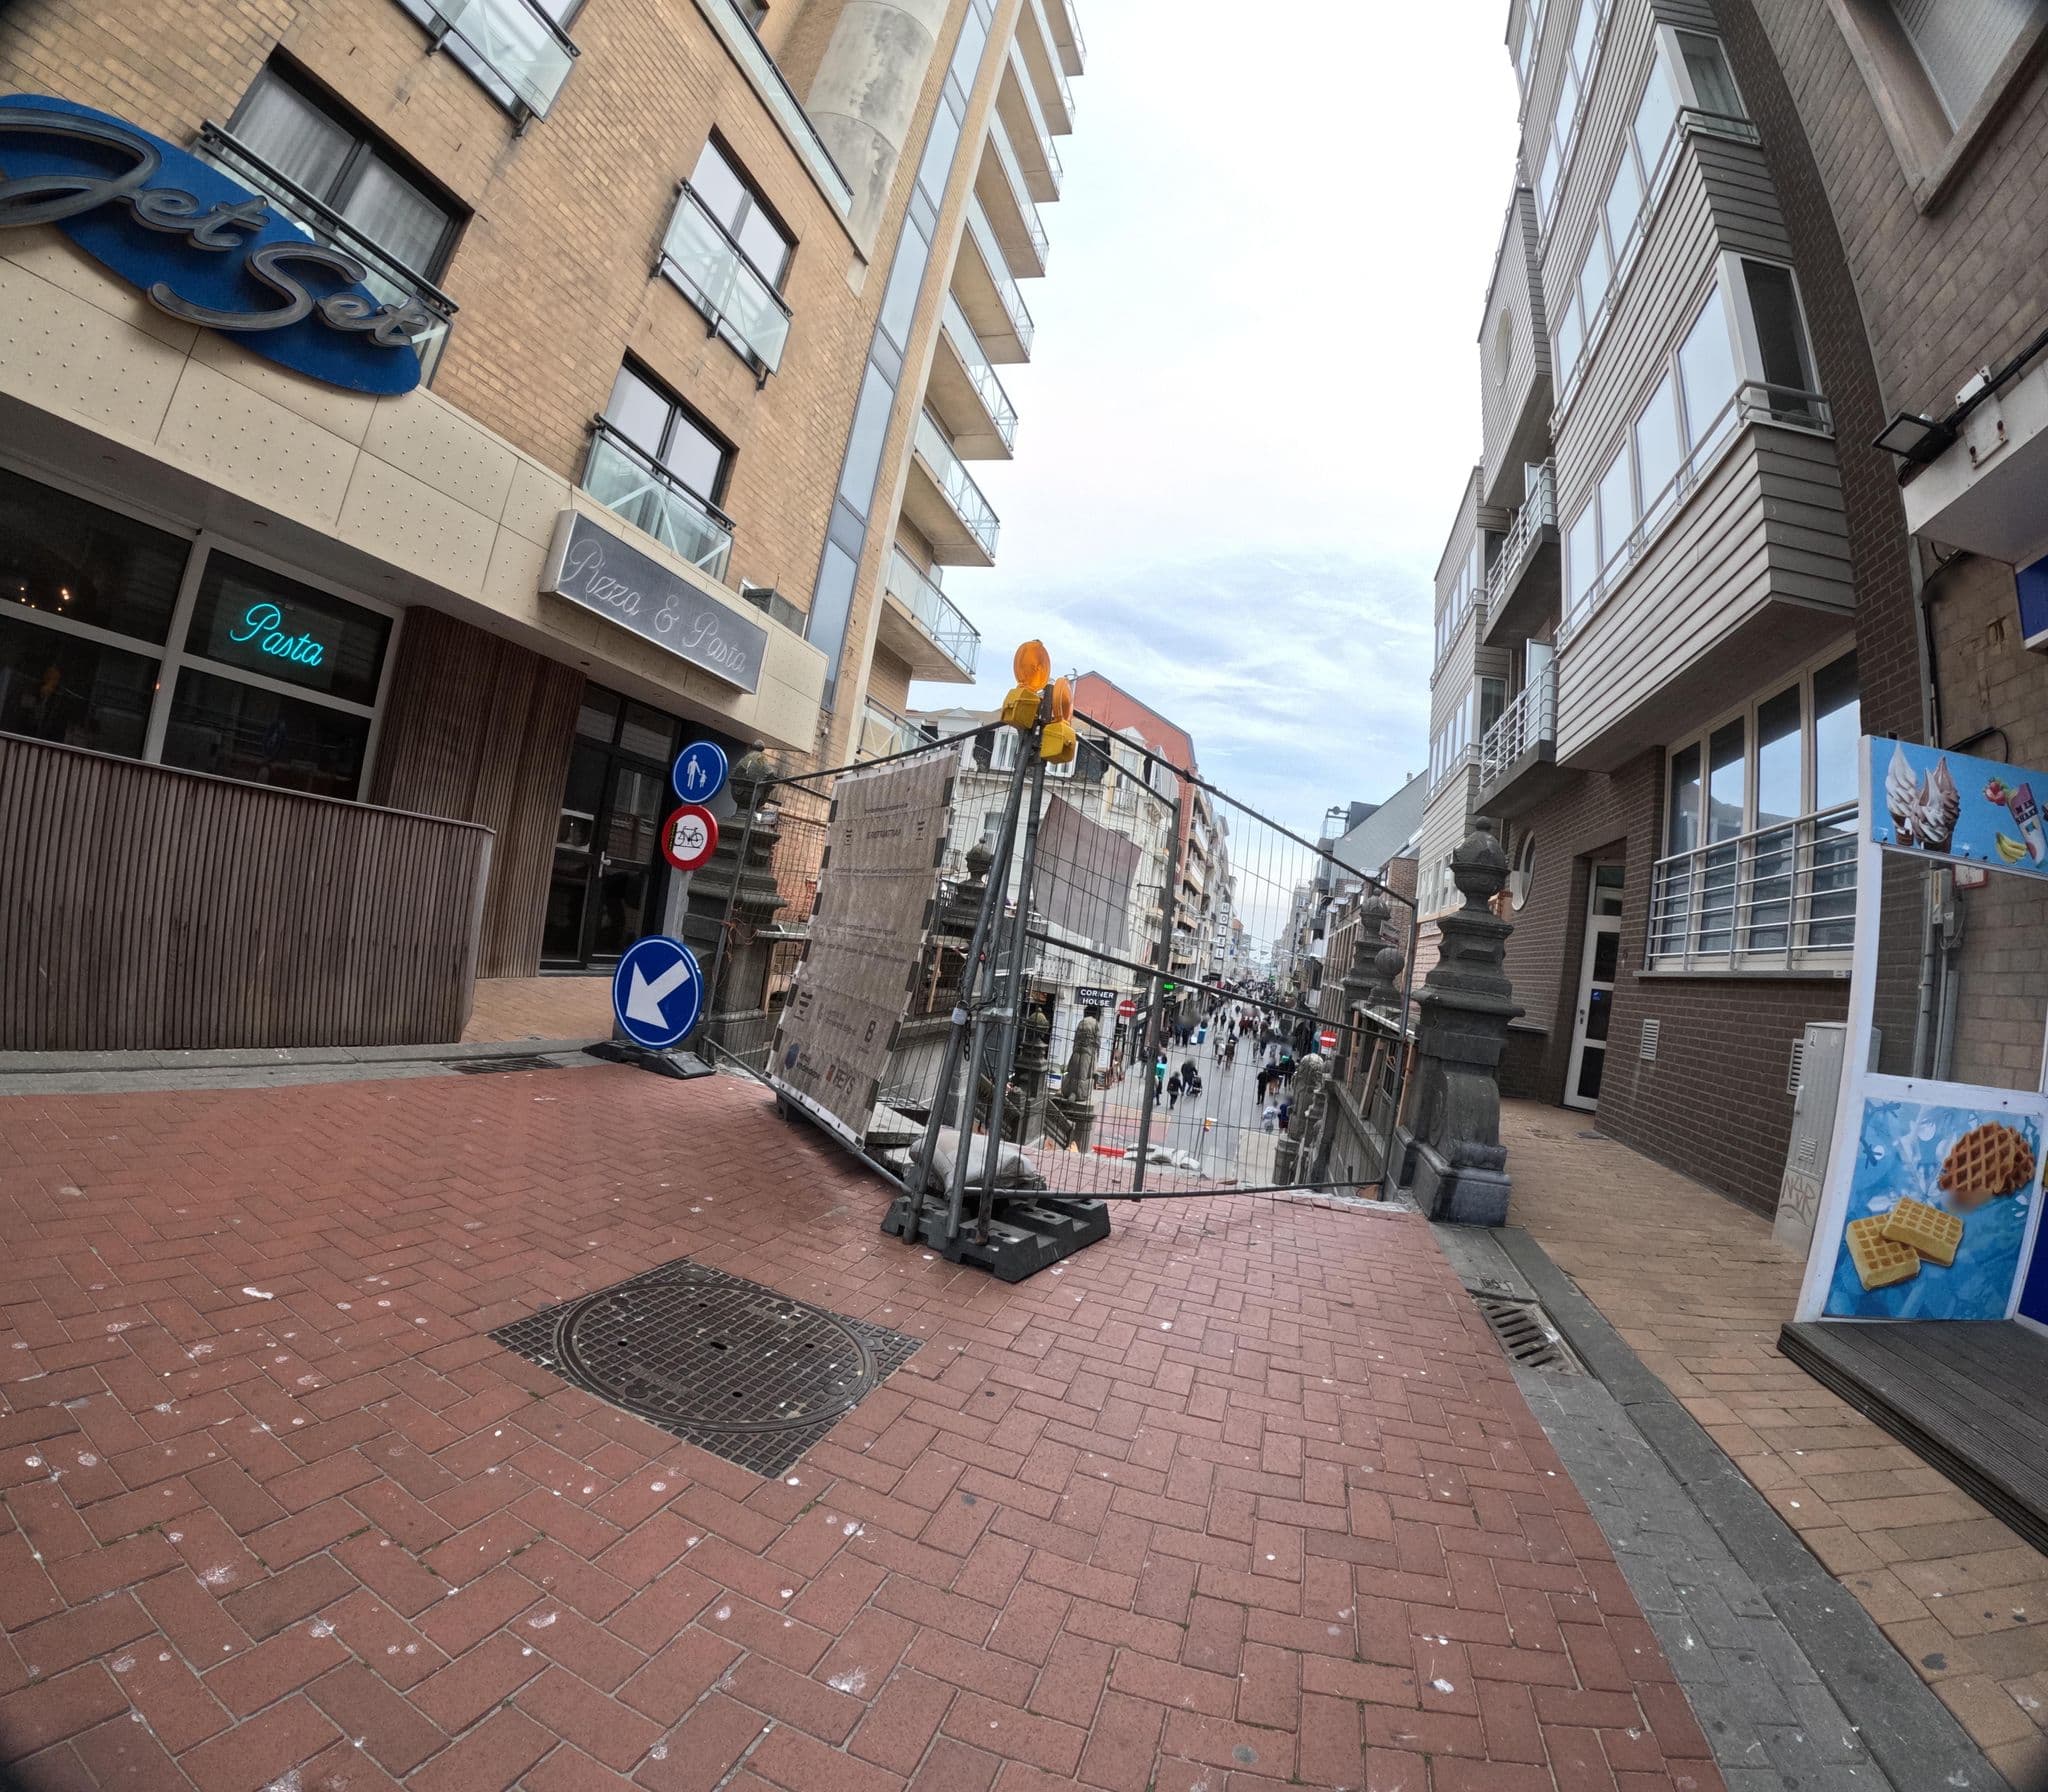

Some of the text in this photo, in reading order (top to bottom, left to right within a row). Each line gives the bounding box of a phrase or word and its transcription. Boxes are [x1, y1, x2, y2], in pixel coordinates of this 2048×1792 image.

[0, 107, 430, 347] Jet Set
[230, 602, 324, 667] Pasta
[559, 538, 747, 672] Pizza & Pasta
[1080, 988, 1115, 999] CORNER
[1082, 998, 1111, 1007] HOUSE
